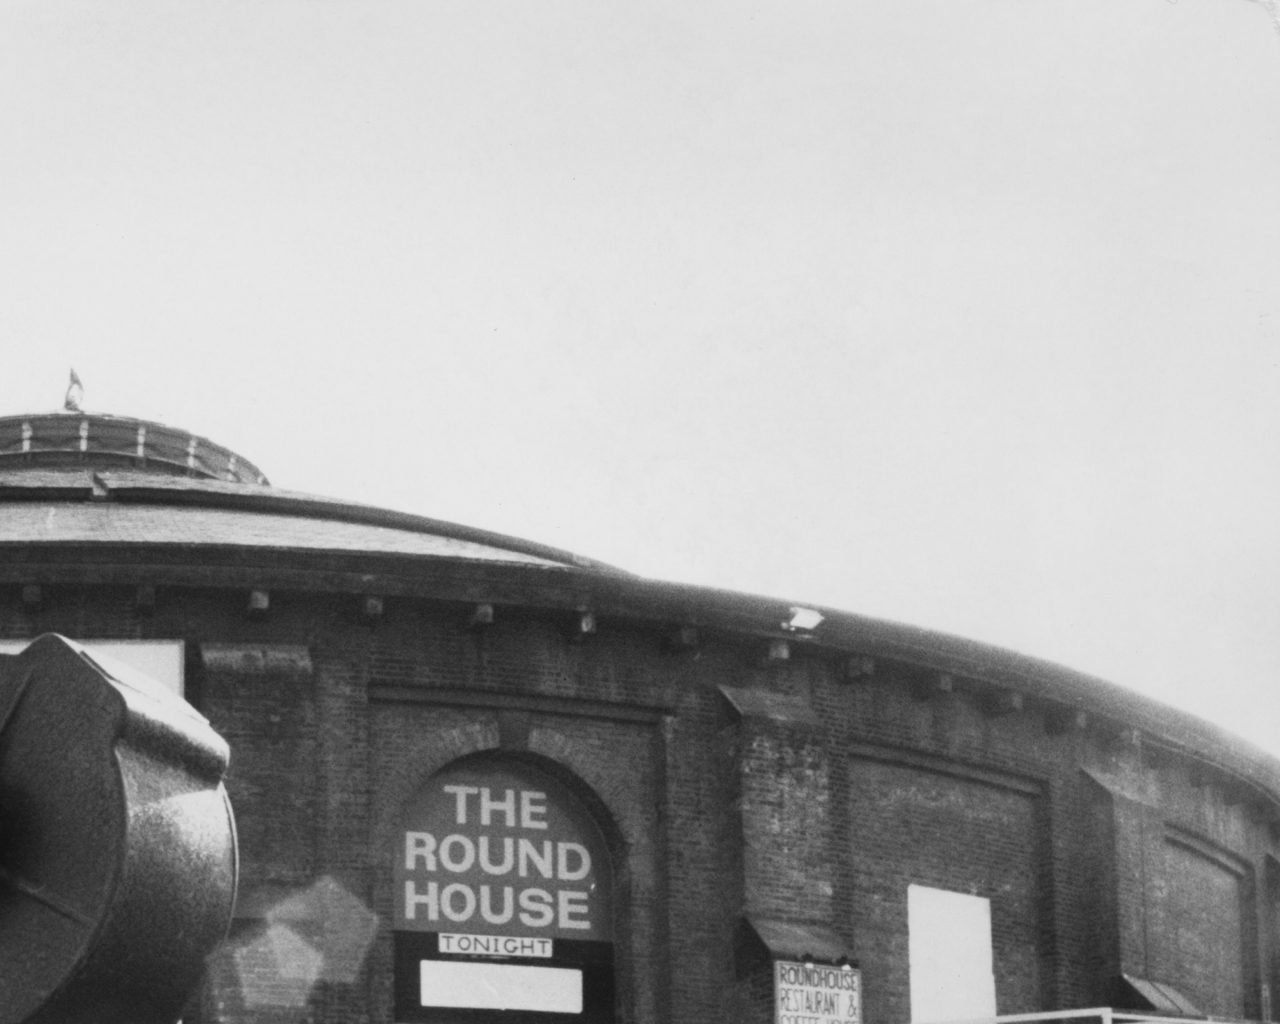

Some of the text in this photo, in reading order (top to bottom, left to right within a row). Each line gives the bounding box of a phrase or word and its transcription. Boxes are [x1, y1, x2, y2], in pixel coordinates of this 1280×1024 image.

[444, 784, 548, 830] THE
[405, 831, 592, 881] ROUND
[404, 880, 591, 930] HOUSE
[441, 936, 550, 955] TONIGHT
